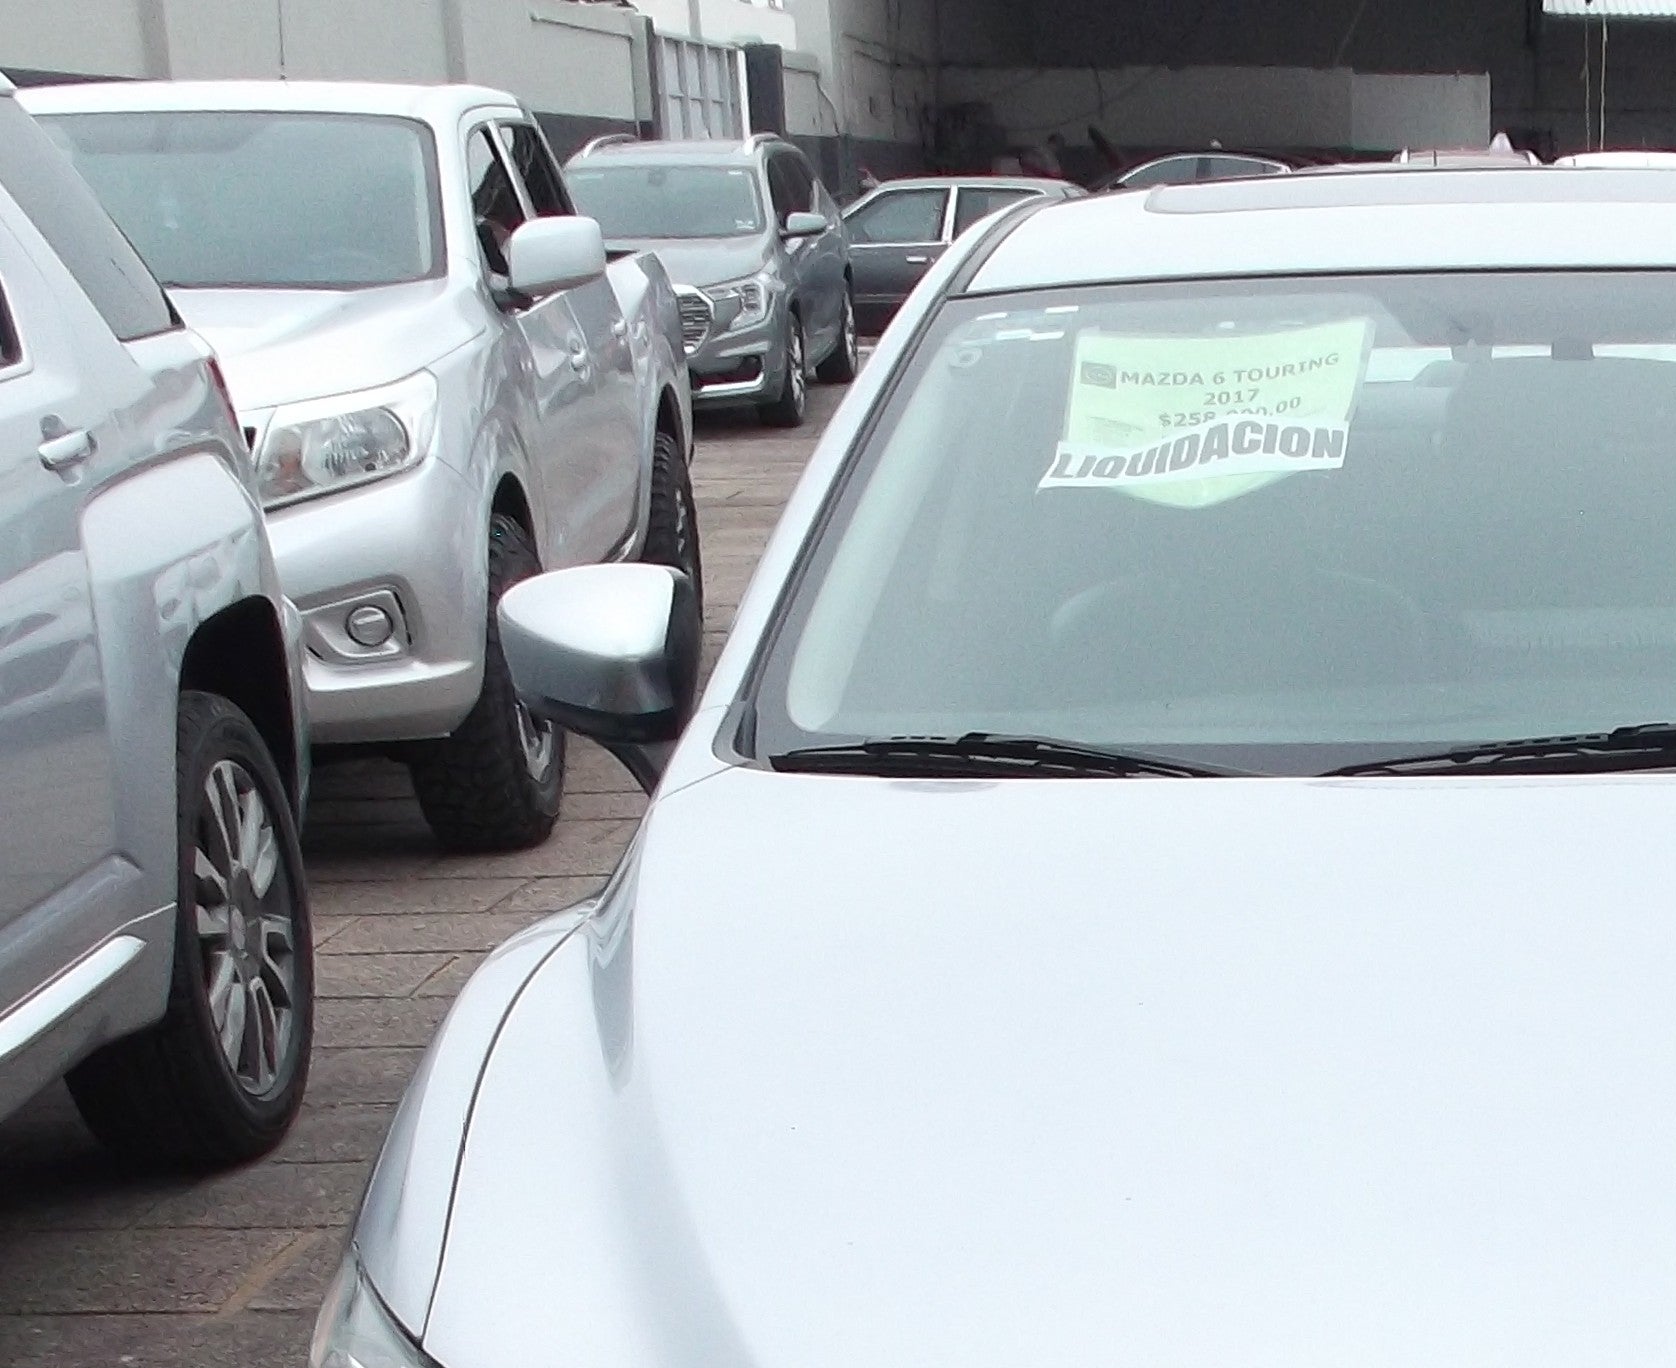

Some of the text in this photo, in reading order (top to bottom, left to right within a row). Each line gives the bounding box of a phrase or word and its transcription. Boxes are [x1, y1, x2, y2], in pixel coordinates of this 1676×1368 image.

[1121, 352, 1340, 387] MAZDA 6 TOURING
[1203, 388, 1261, 406] 2017
[1048, 419, 1345, 480] LIQUIDACION
